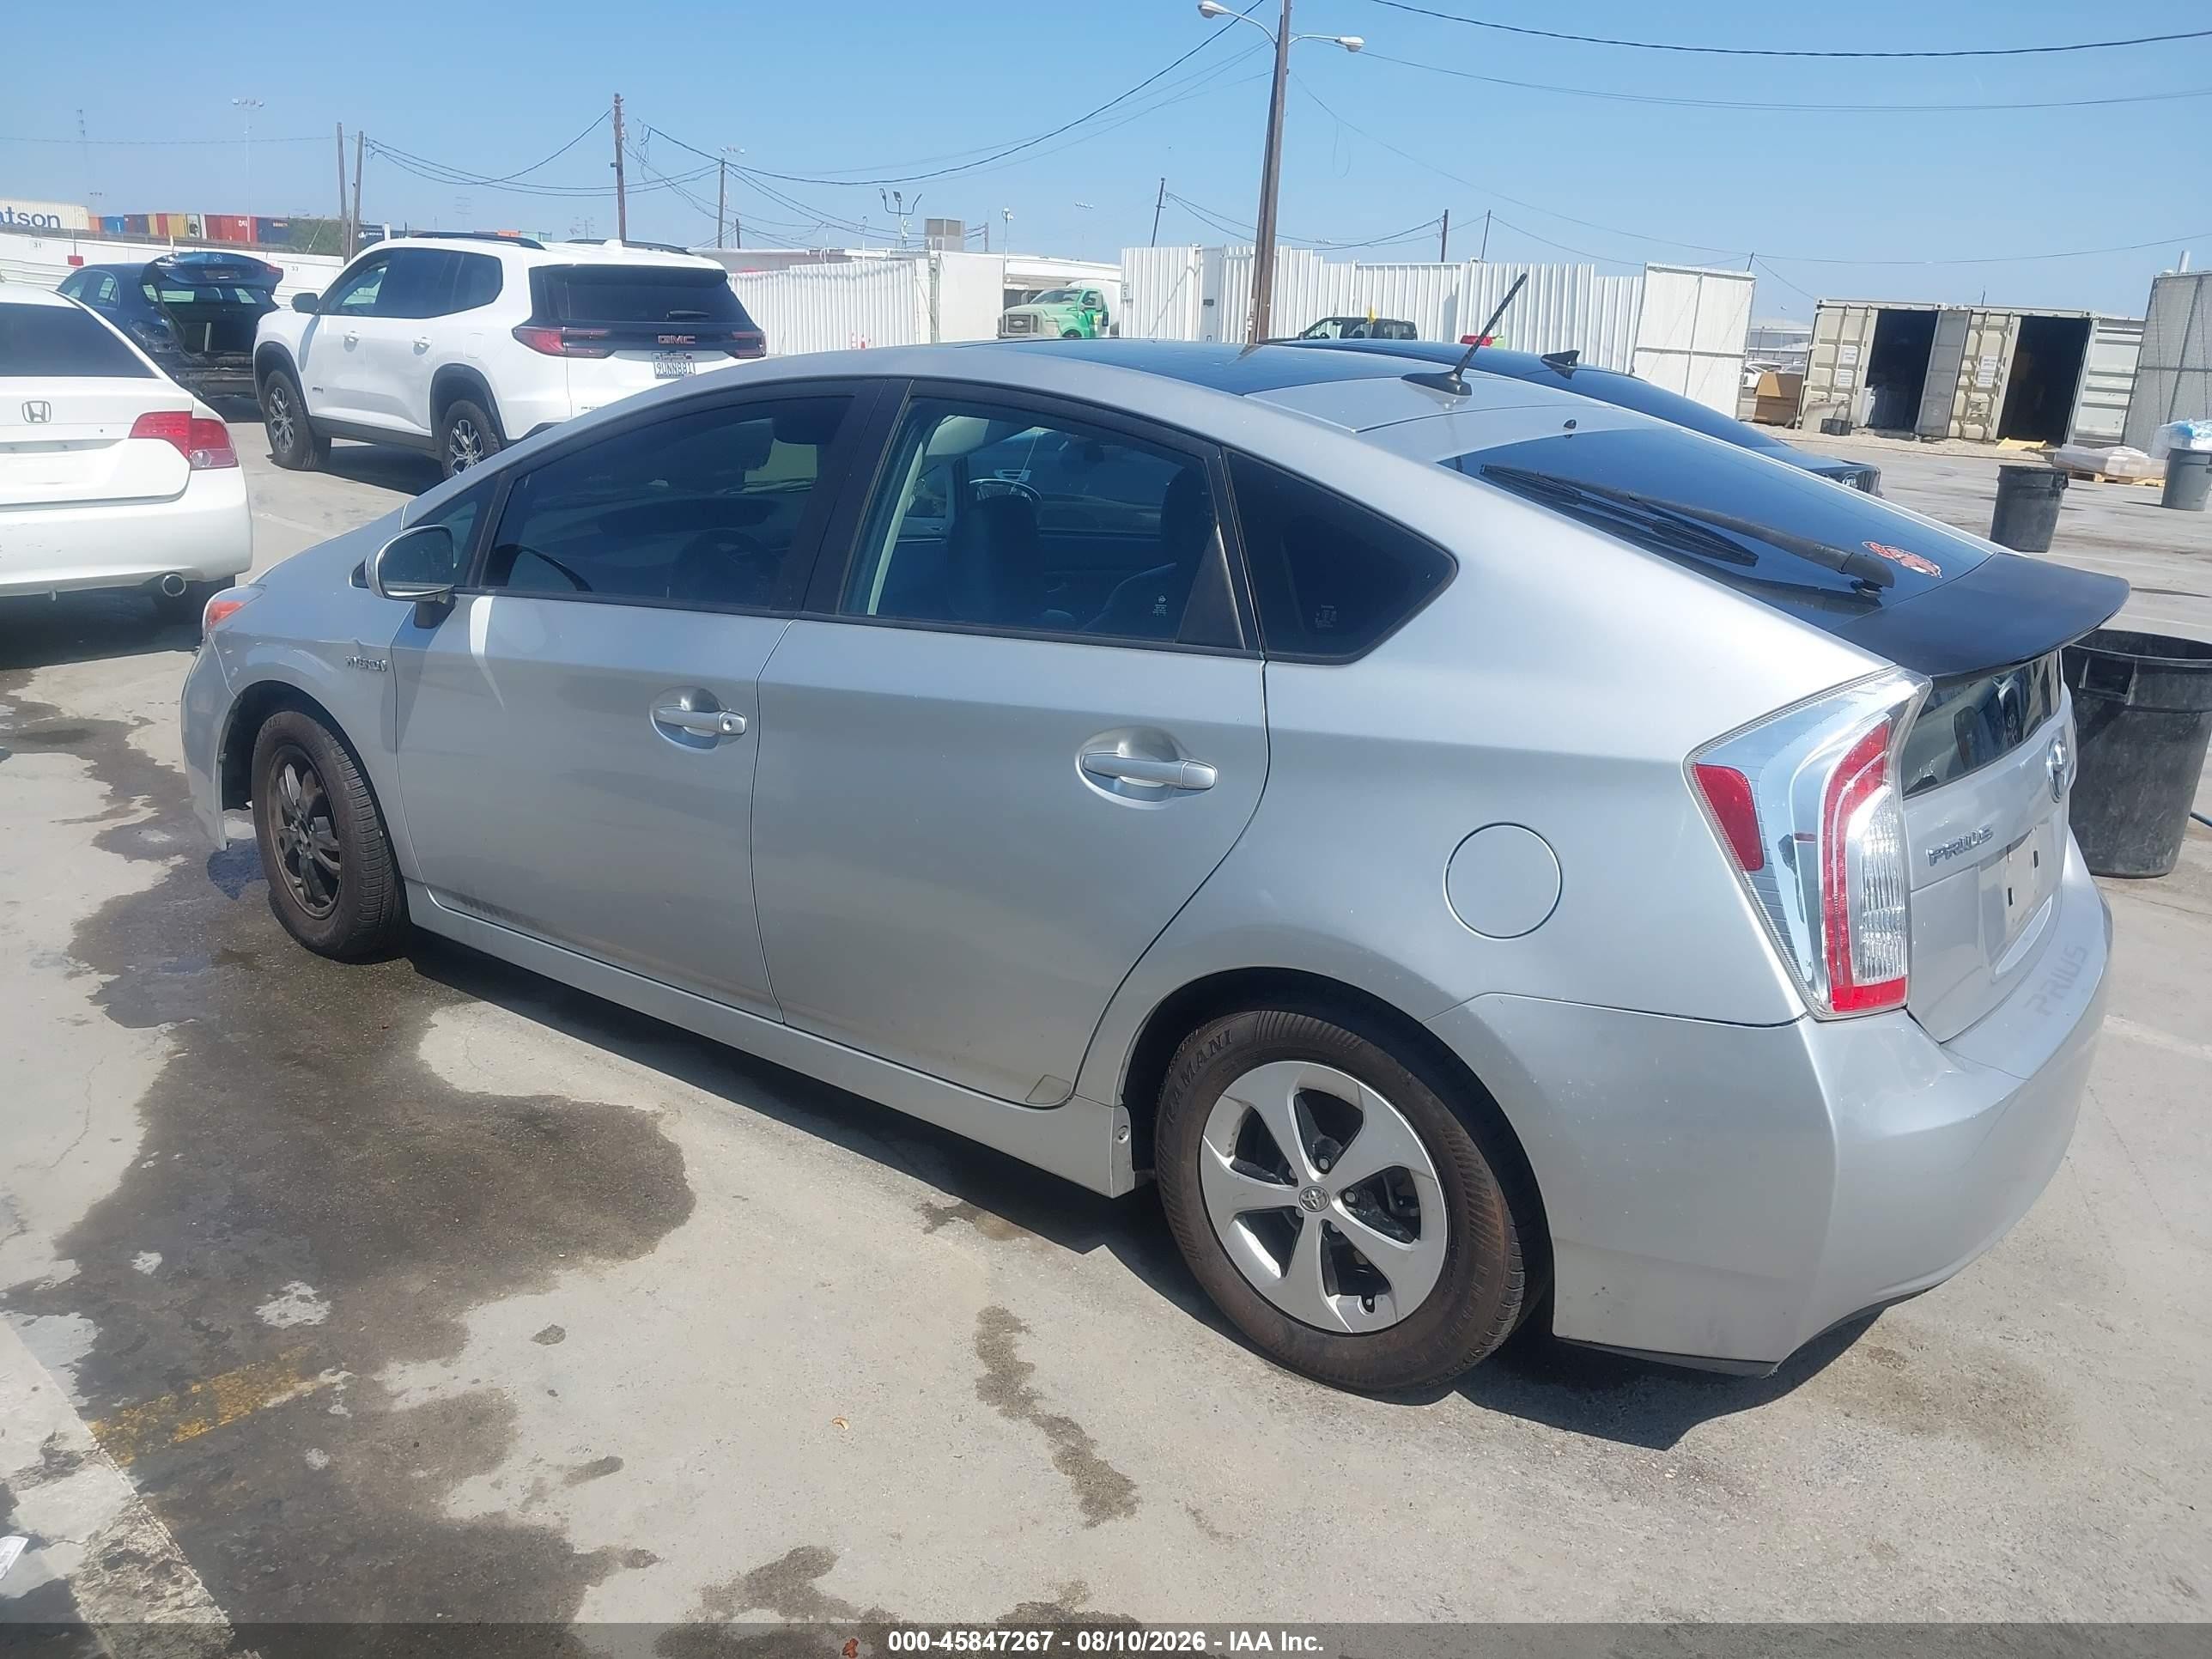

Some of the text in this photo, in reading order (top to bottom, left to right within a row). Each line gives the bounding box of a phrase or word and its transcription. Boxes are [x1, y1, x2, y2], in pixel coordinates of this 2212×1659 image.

[658, 335, 696, 344] GMC
[1925, 824, 1994, 867] PRIUS
[2022, 945, 2090, 1018] PRIUS
